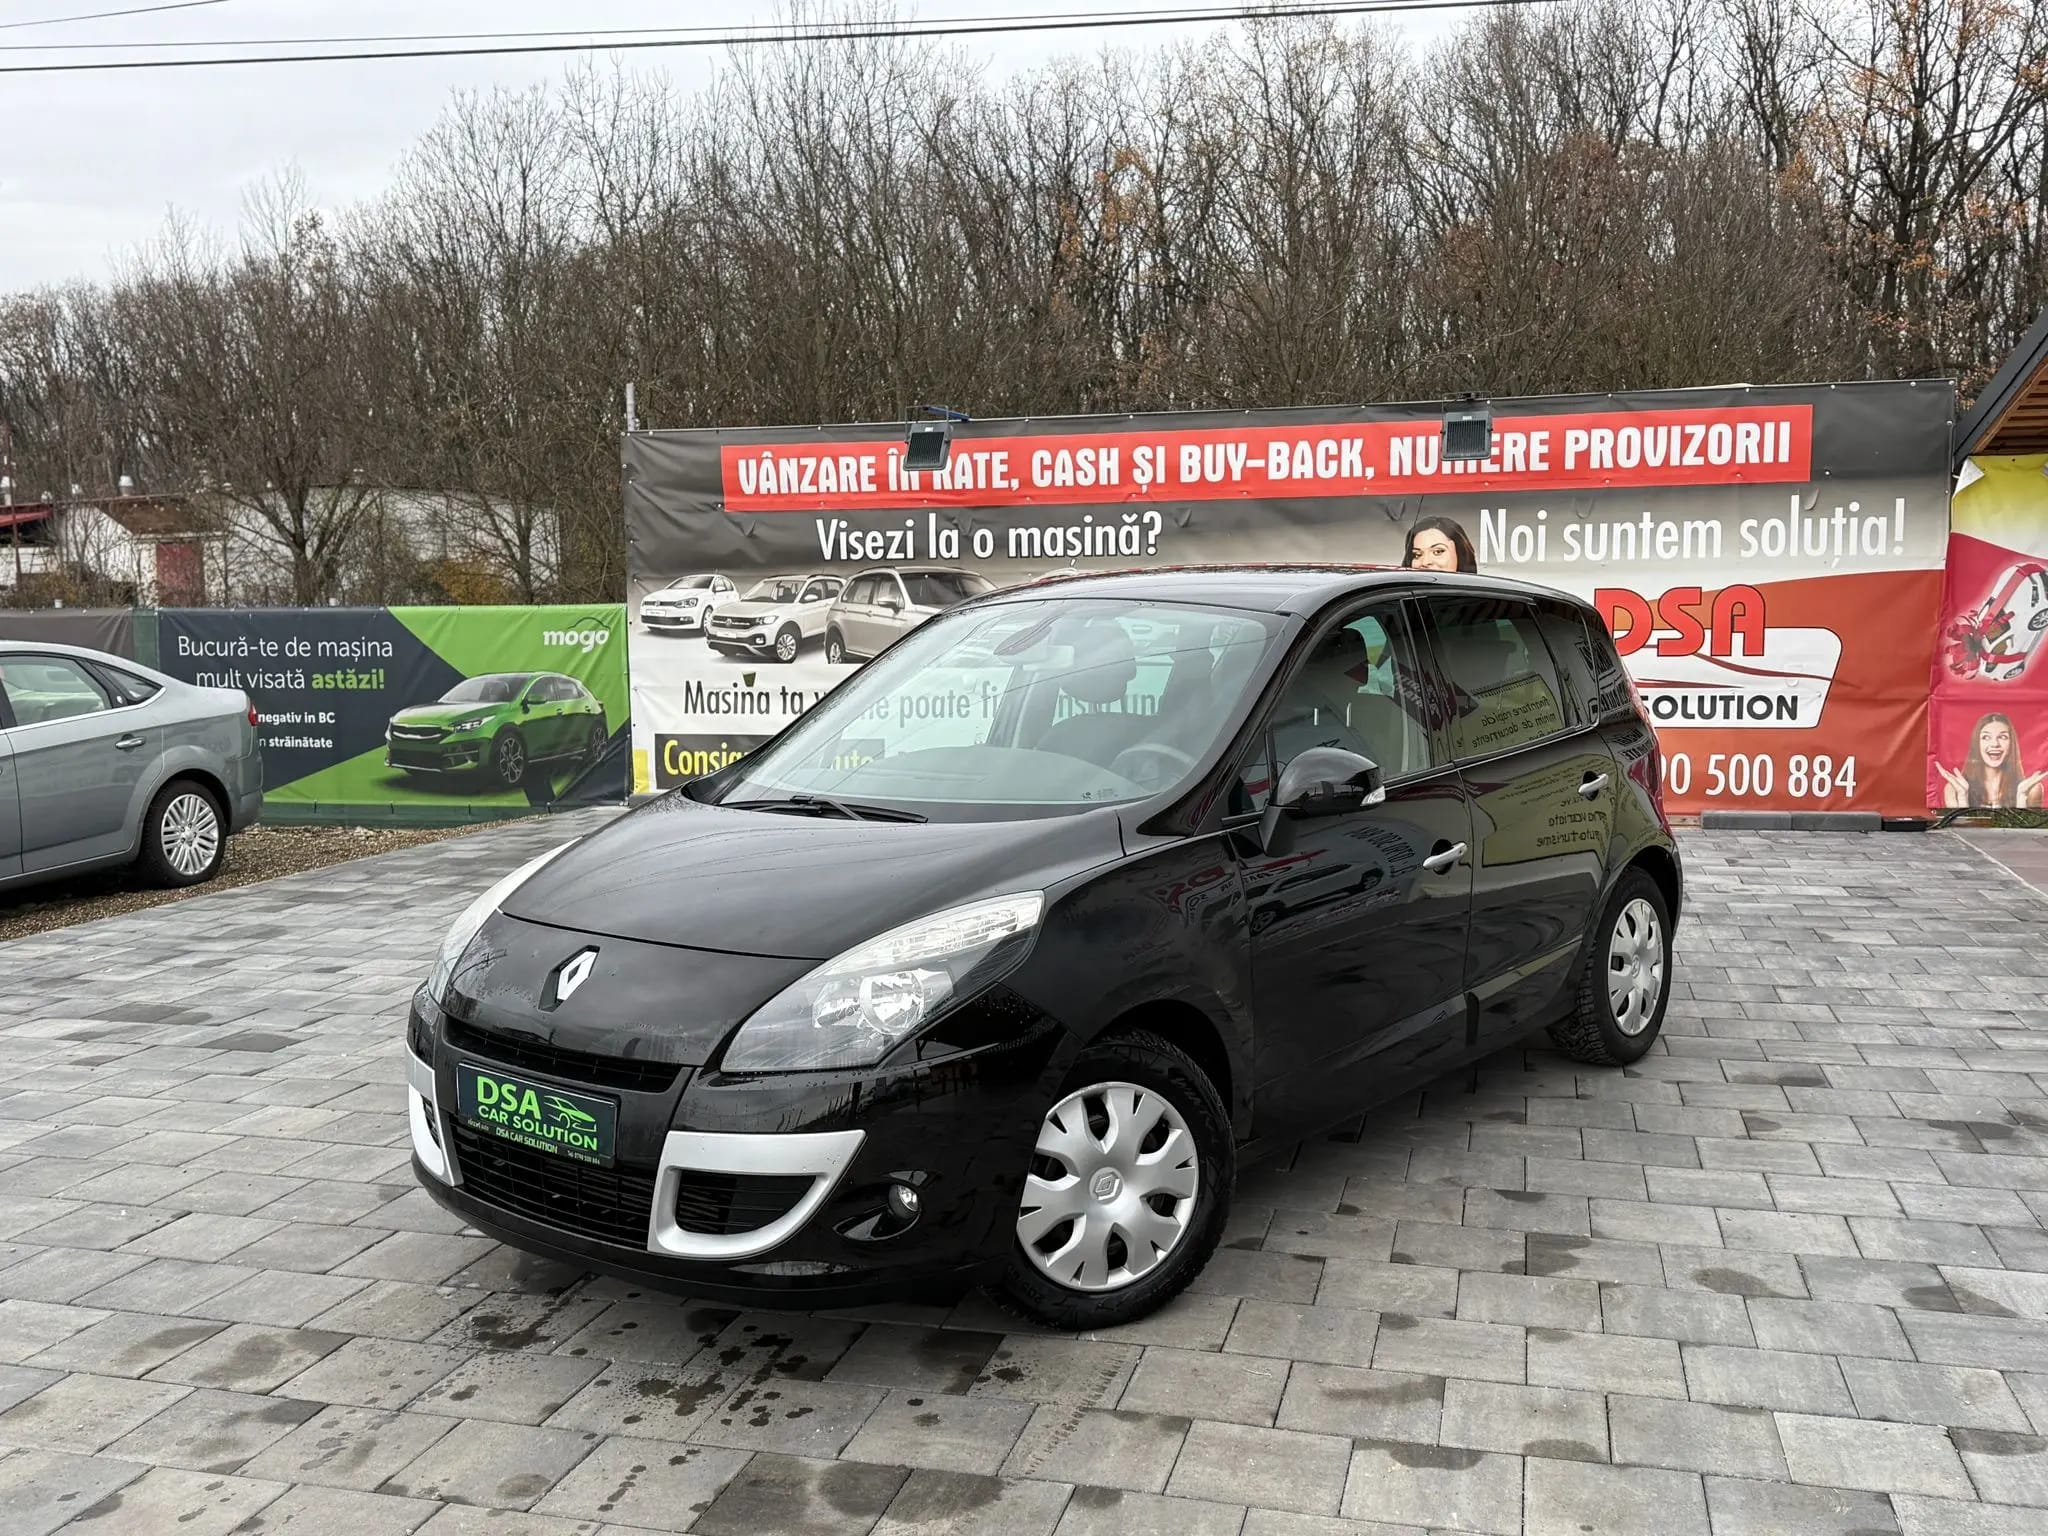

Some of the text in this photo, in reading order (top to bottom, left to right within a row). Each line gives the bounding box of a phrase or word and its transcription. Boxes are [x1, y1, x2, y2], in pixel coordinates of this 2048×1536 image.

[737, 450, 877, 496] VÂNZARE
[1031, 446, 1120, 487] CASH
[1132, 443, 1167, 494] ȘI
[1390, 430, 1550, 477] NUERE
[1564, 421, 1791, 471] PROVIZORII
[815, 510, 1164, 566] Visezi la o mașină?
[1479, 494, 1906, 568] Noi suntem soluția!
[542, 629, 610, 654] mogo
[1594, 583, 1767, 658] DSA
[178, 634, 393, 663] Bucură-te de mașina
[196, 667, 385, 690] mult visată astăzi!
[258, 711, 303, 727] negativ
[318, 711, 336, 724] BC
[779, 685, 804, 716] ta
[899, 686, 970, 729] poate
[268, 735, 334, 749] străinătate
[1704, 753, 1774, 796] 500
[1787, 754, 1858, 798] 884
[477, 1076, 542, 1120] DSA
[477, 1105, 509, 1125] CAR
[512, 1115, 598, 1150] SOLUTION
